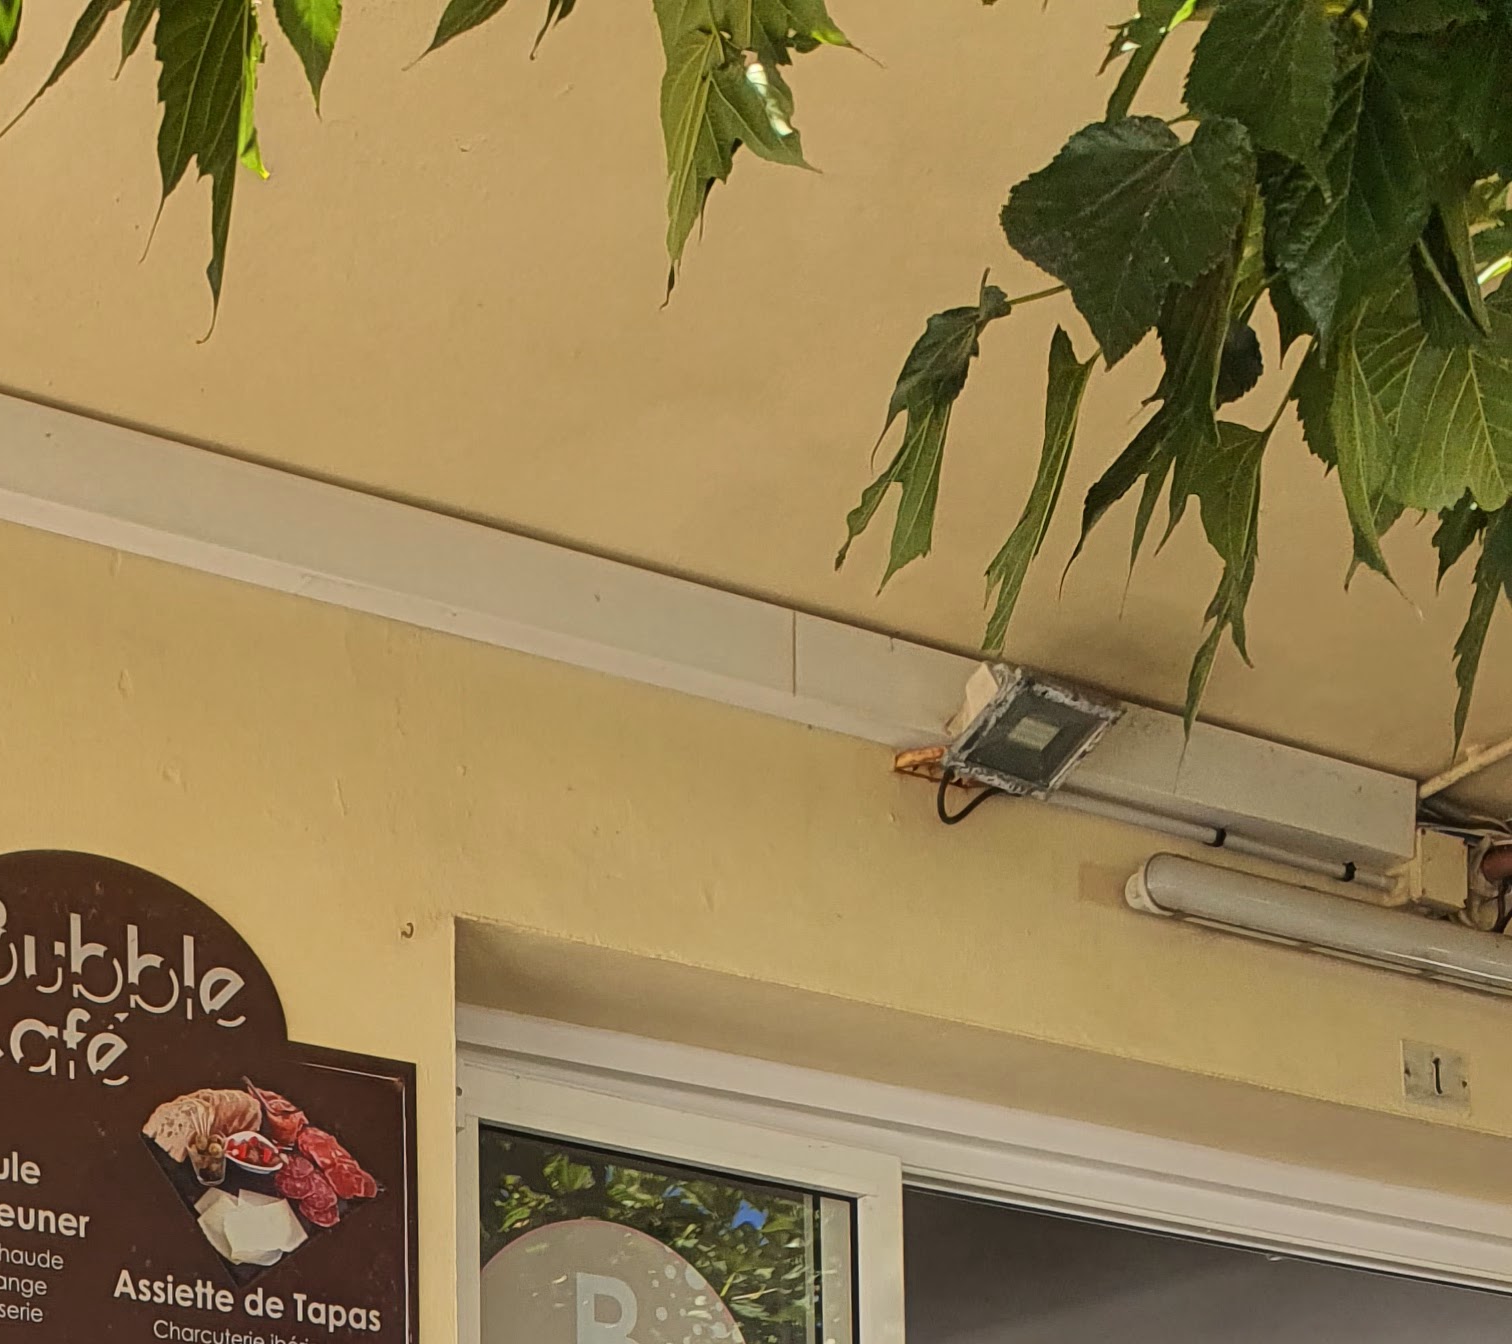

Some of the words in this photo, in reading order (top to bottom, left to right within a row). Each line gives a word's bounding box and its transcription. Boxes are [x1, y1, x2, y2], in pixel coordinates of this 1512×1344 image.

[113, 1269, 235, 1313] Assiette
[244, 1287, 285, 1319] de
[292, 1293, 382, 1333] Tapas
